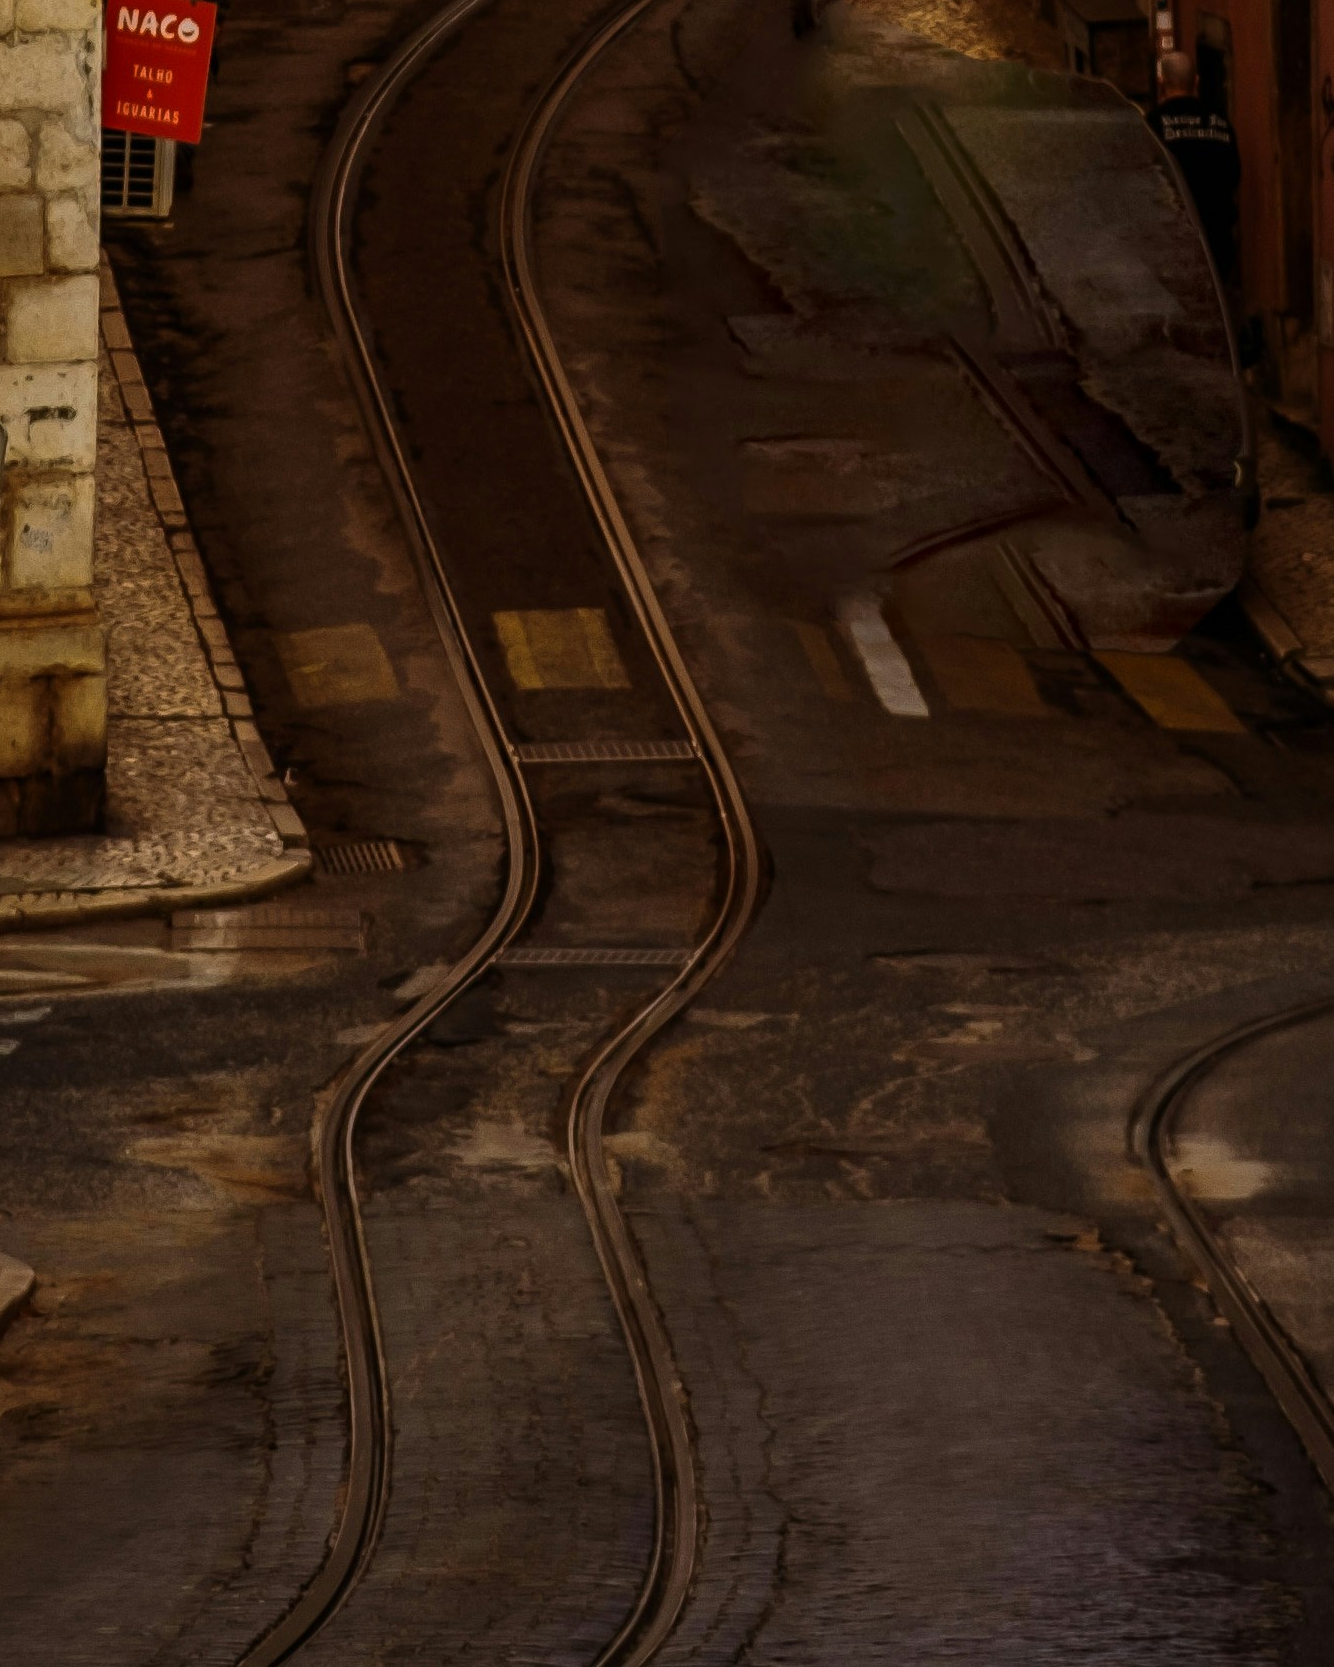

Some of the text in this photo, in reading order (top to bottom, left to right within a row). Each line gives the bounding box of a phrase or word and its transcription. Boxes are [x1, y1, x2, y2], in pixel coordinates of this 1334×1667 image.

[117, 6, 200, 44] NACO
[133, 63, 174, 85] TALHO
[116, 100, 180, 126] IGUARIAS
